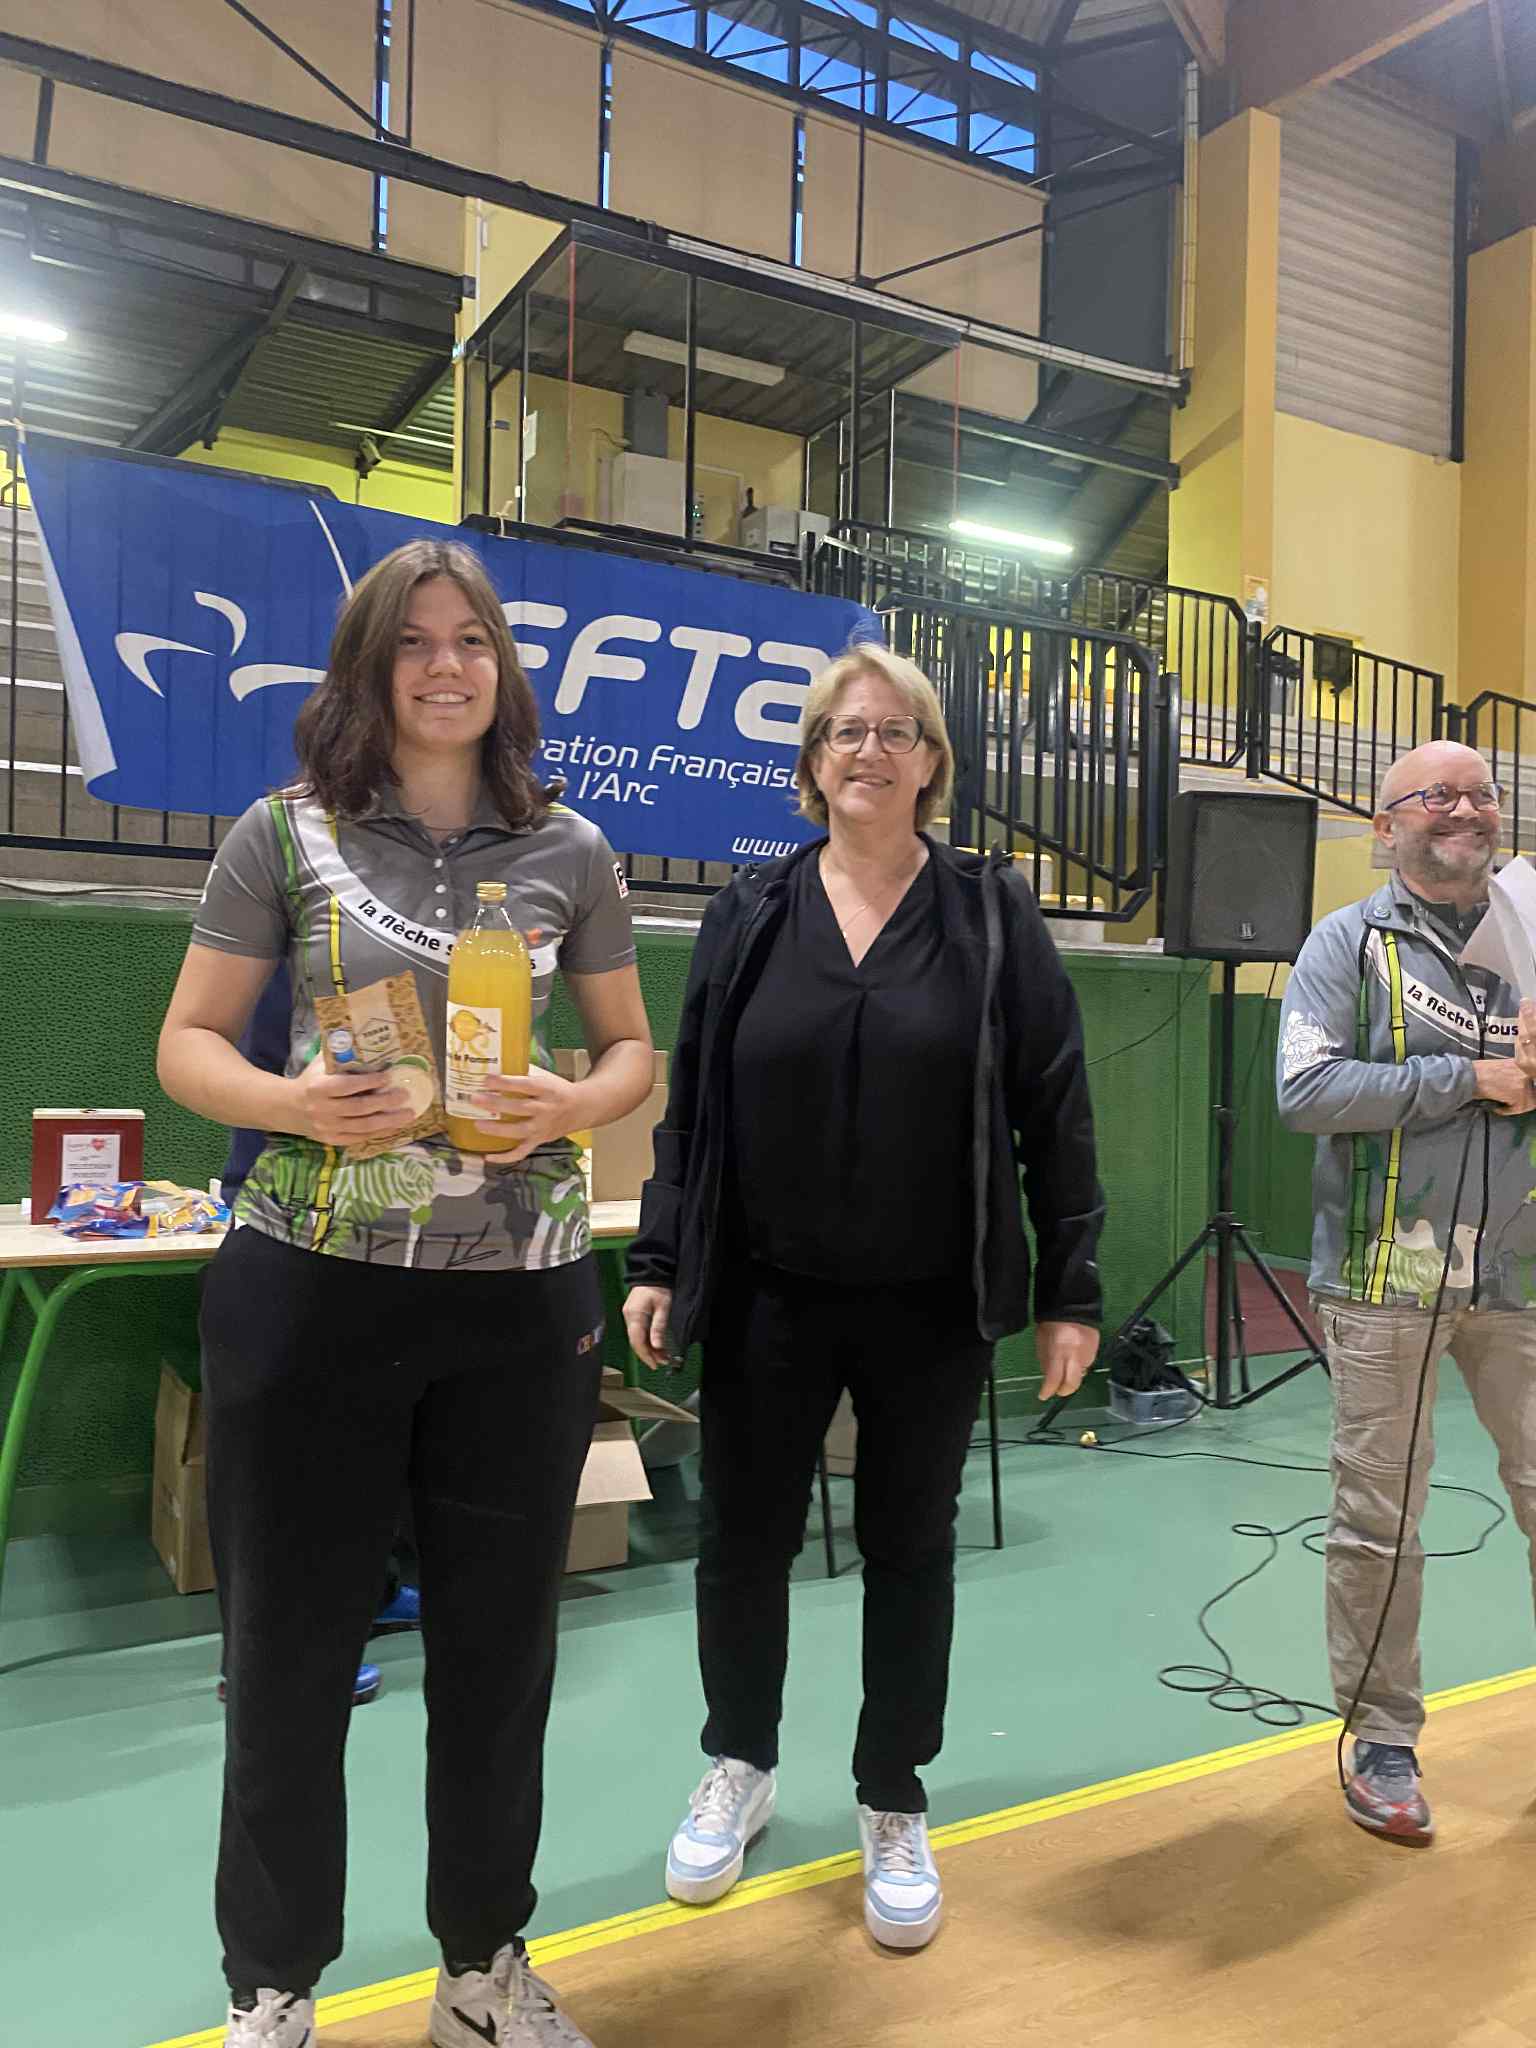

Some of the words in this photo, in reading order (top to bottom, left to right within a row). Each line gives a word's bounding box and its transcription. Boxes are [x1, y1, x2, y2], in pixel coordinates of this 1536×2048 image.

[540, 735, 639, 769] ation
[578, 770, 659, 805] l'Arc
[358, 899, 377, 918] la
[378, 914, 440, 951] flèche
[1407, 984, 1423, 1001] la
[1426, 996, 1475, 1031] flèche
